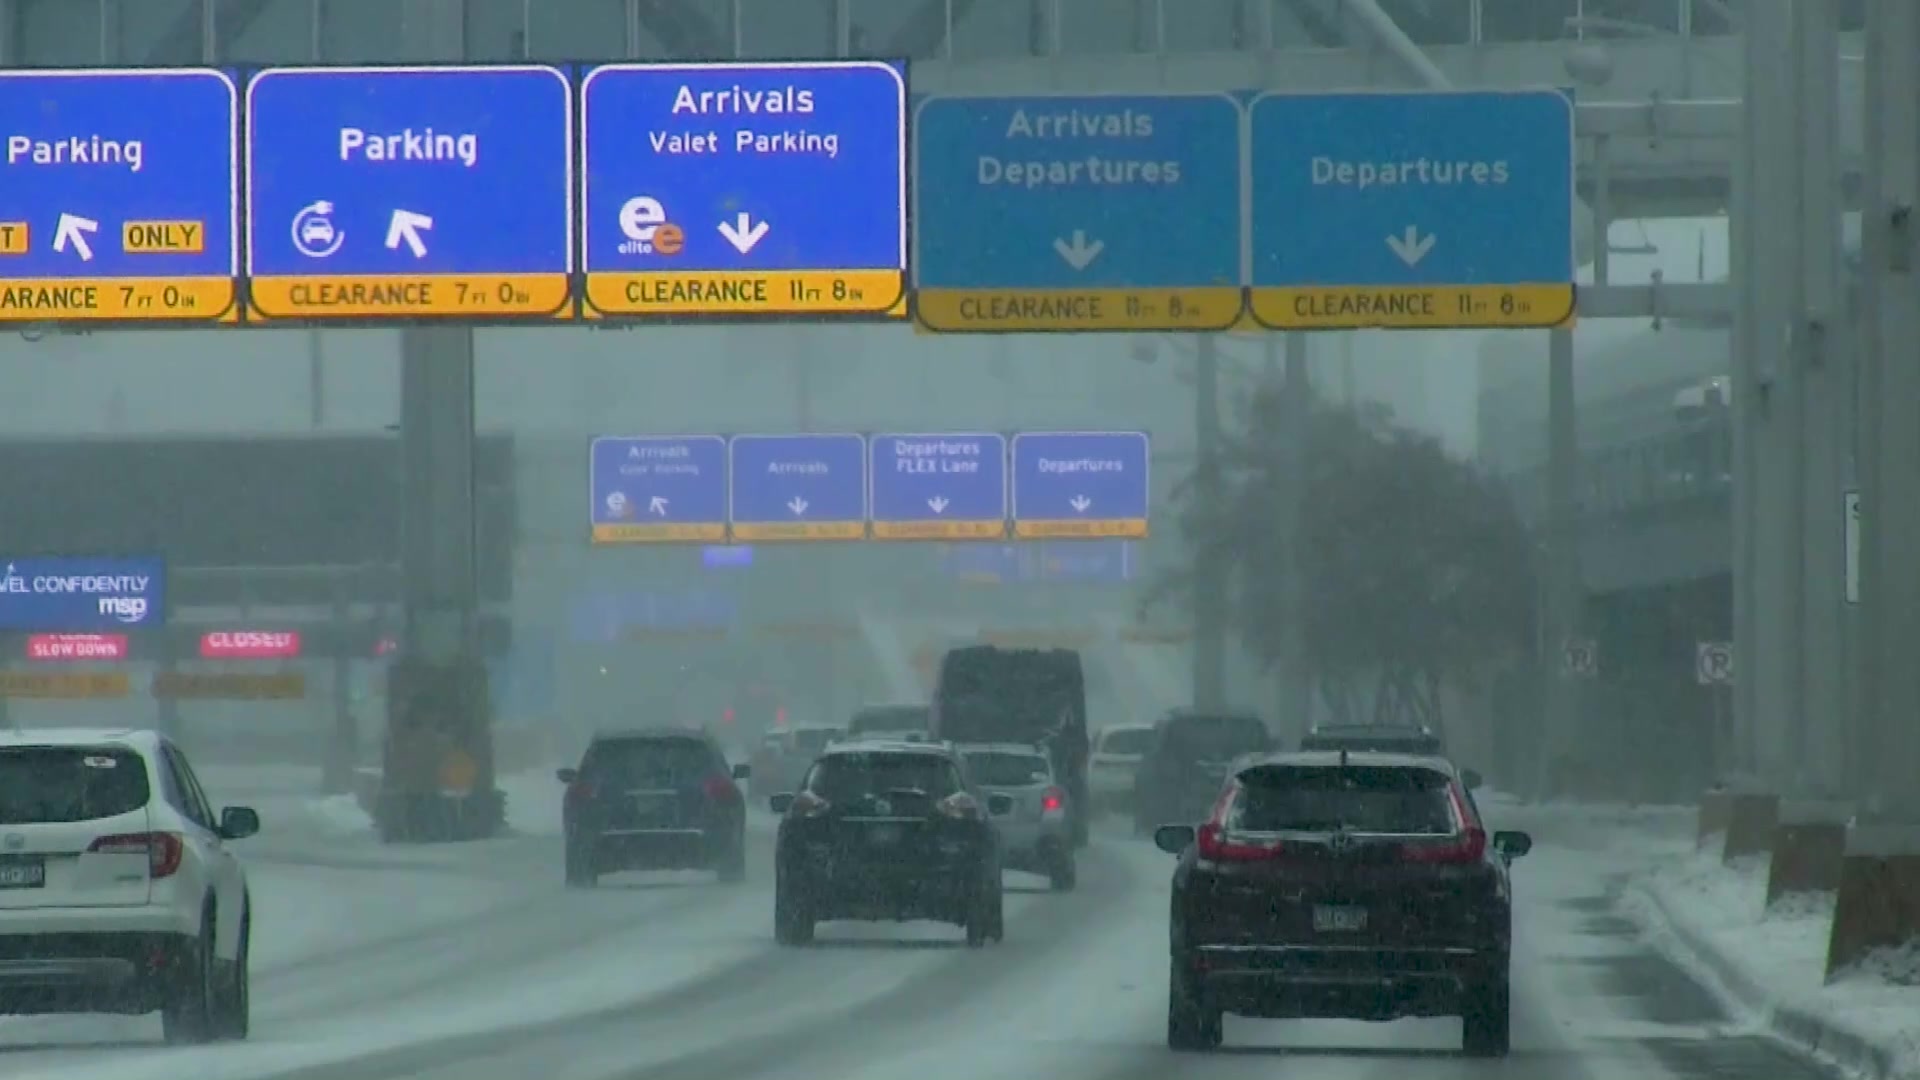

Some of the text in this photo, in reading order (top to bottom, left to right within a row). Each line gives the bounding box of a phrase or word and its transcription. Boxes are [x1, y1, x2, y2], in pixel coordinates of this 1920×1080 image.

[671, 84, 815, 115] Arrivals
[1005, 108, 1154, 138] Arrivals
[7, 134, 143, 172] Parking
[339, 128, 478, 167] Parking
[649, 130, 839, 158] Valet Parking
[977, 155, 1181, 190] Departures
[1311, 156, 1510, 192] Departures
[128, 225, 197, 248] ONLY
[617, 240, 653, 255] elite
[0, 286, 98, 309] ARANCE
[289, 282, 432, 305] CLEARANCE
[626, 279, 767, 302] CLEARANCE
[959, 296, 1103, 320] CLEARANCE
[1293, 293, 1434, 316] CLEARANCE
[628, 445, 690, 458] Arrivals
[894, 439, 981, 457] Departures
[767, 461, 829, 474] Arrivals
[896, 457, 980, 473] FLEX Lane
[1038, 457, 1123, 475] Departures
[33, 575, 150, 593] CONFIDENTLY
[98, 596, 148, 619] msp
[34, 643, 118, 658] SLOW DOWN
[207, 631, 292, 648] CLOSED
